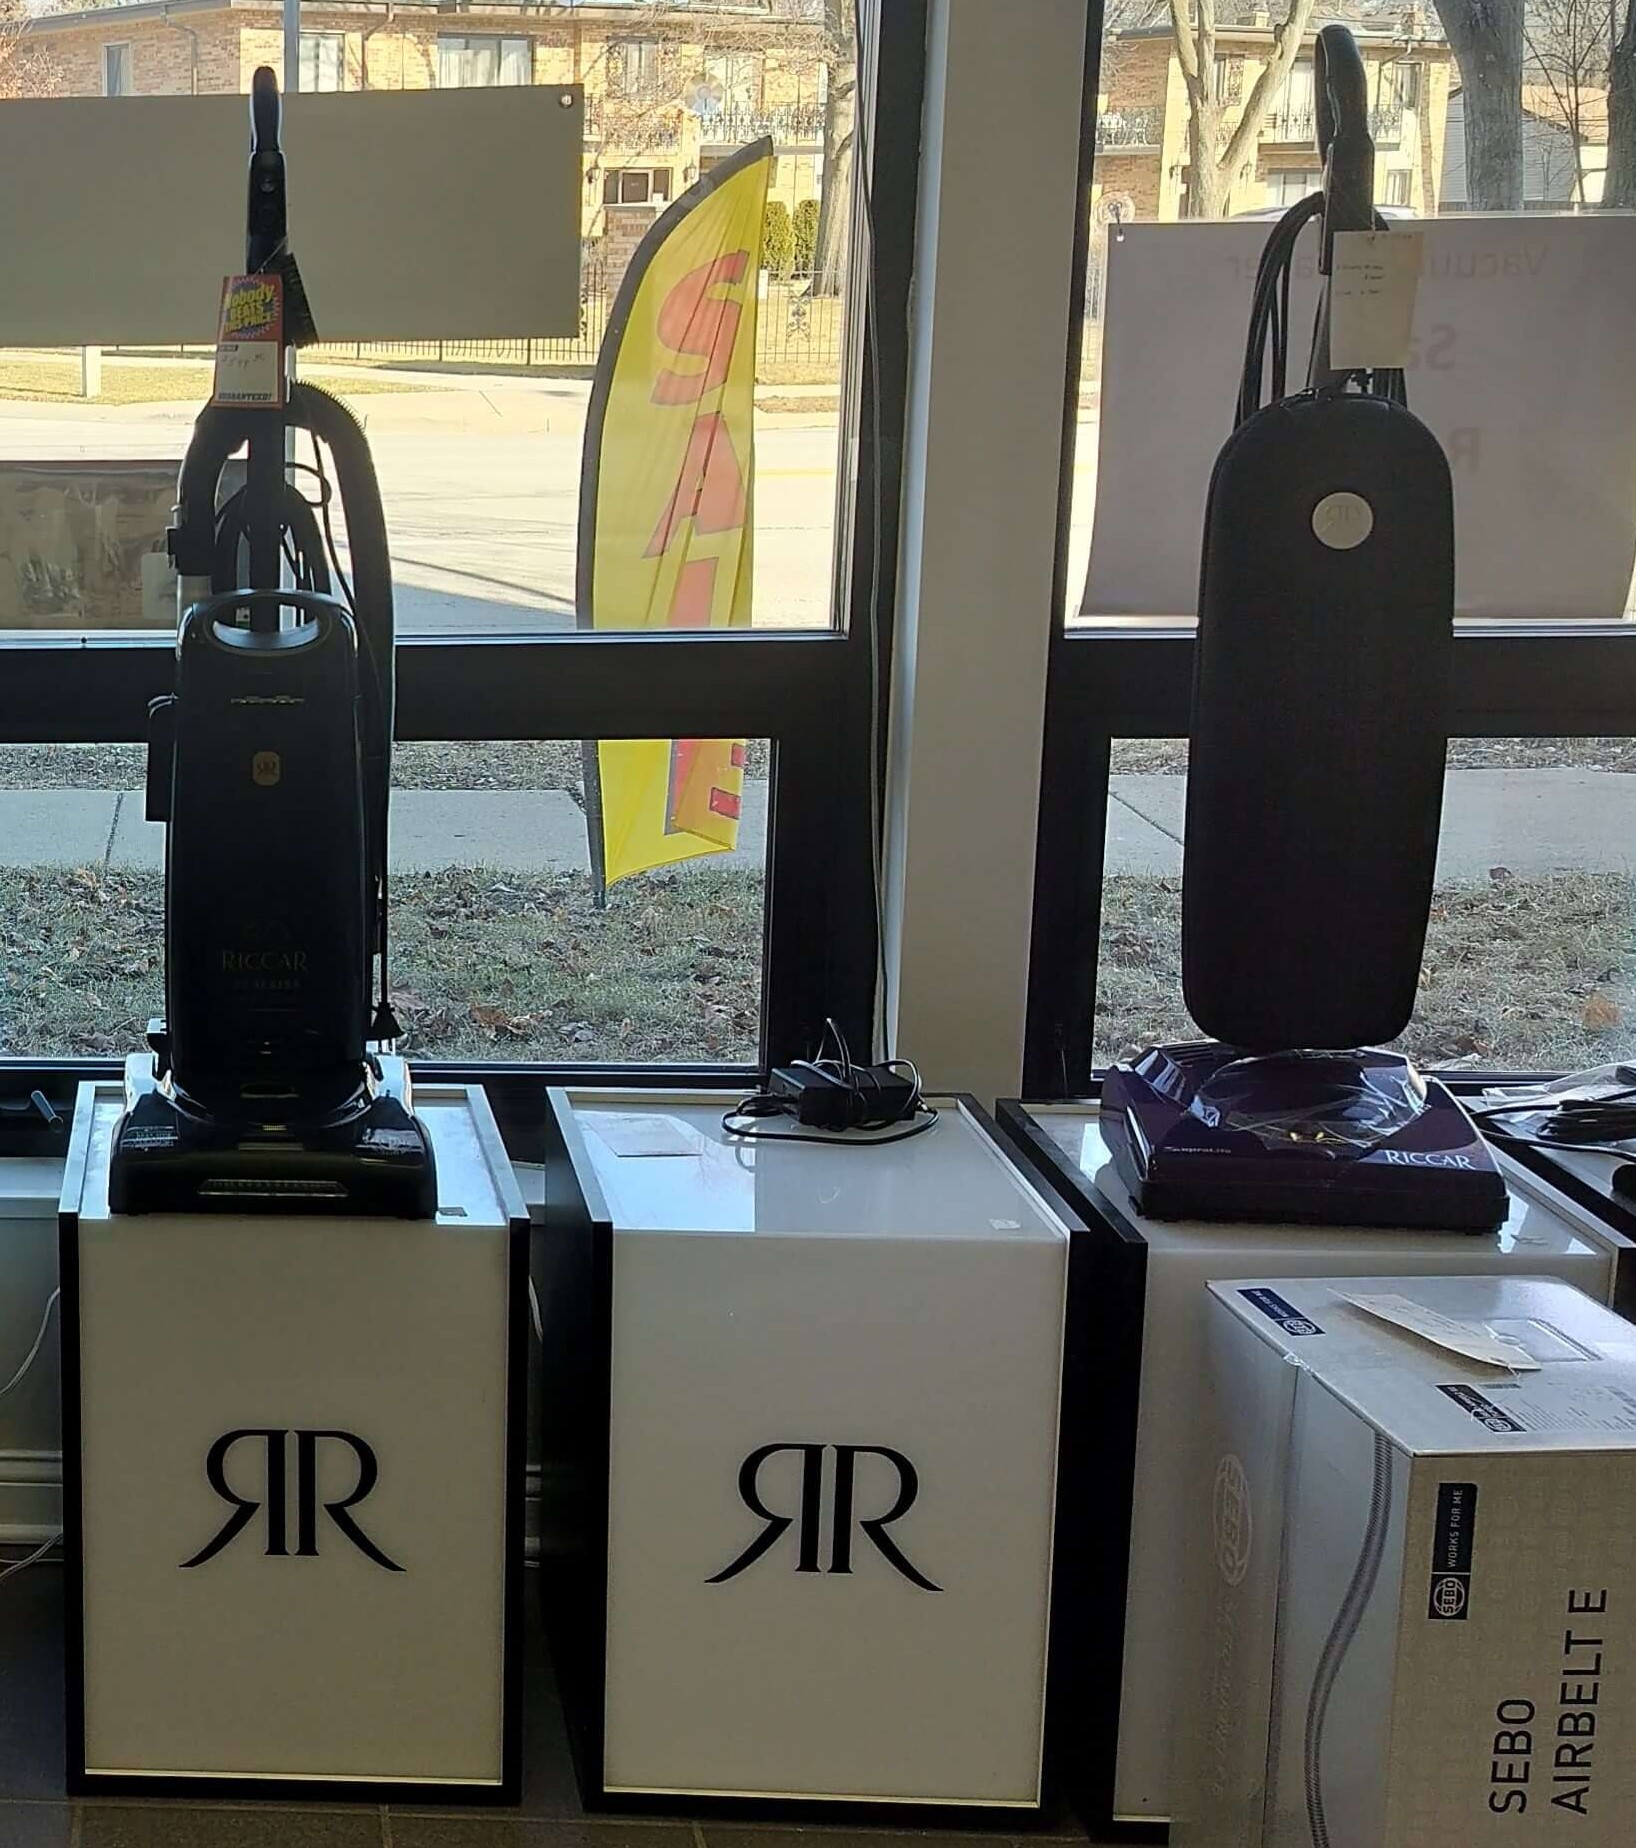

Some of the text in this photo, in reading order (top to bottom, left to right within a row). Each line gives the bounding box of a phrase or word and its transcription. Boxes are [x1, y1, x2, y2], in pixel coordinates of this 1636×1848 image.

[222, 949, 309, 971] RICCAR
[1385, 1149, 1476, 1170] RICCAR
[1447, 1489, 1463, 1568] WORKS FOR ME
[1442, 1579, 1457, 1614] SEBO
[1551, 1589, 1607, 1815] AIRBELT E
[1489, 1699, 1535, 1813] SEBO
